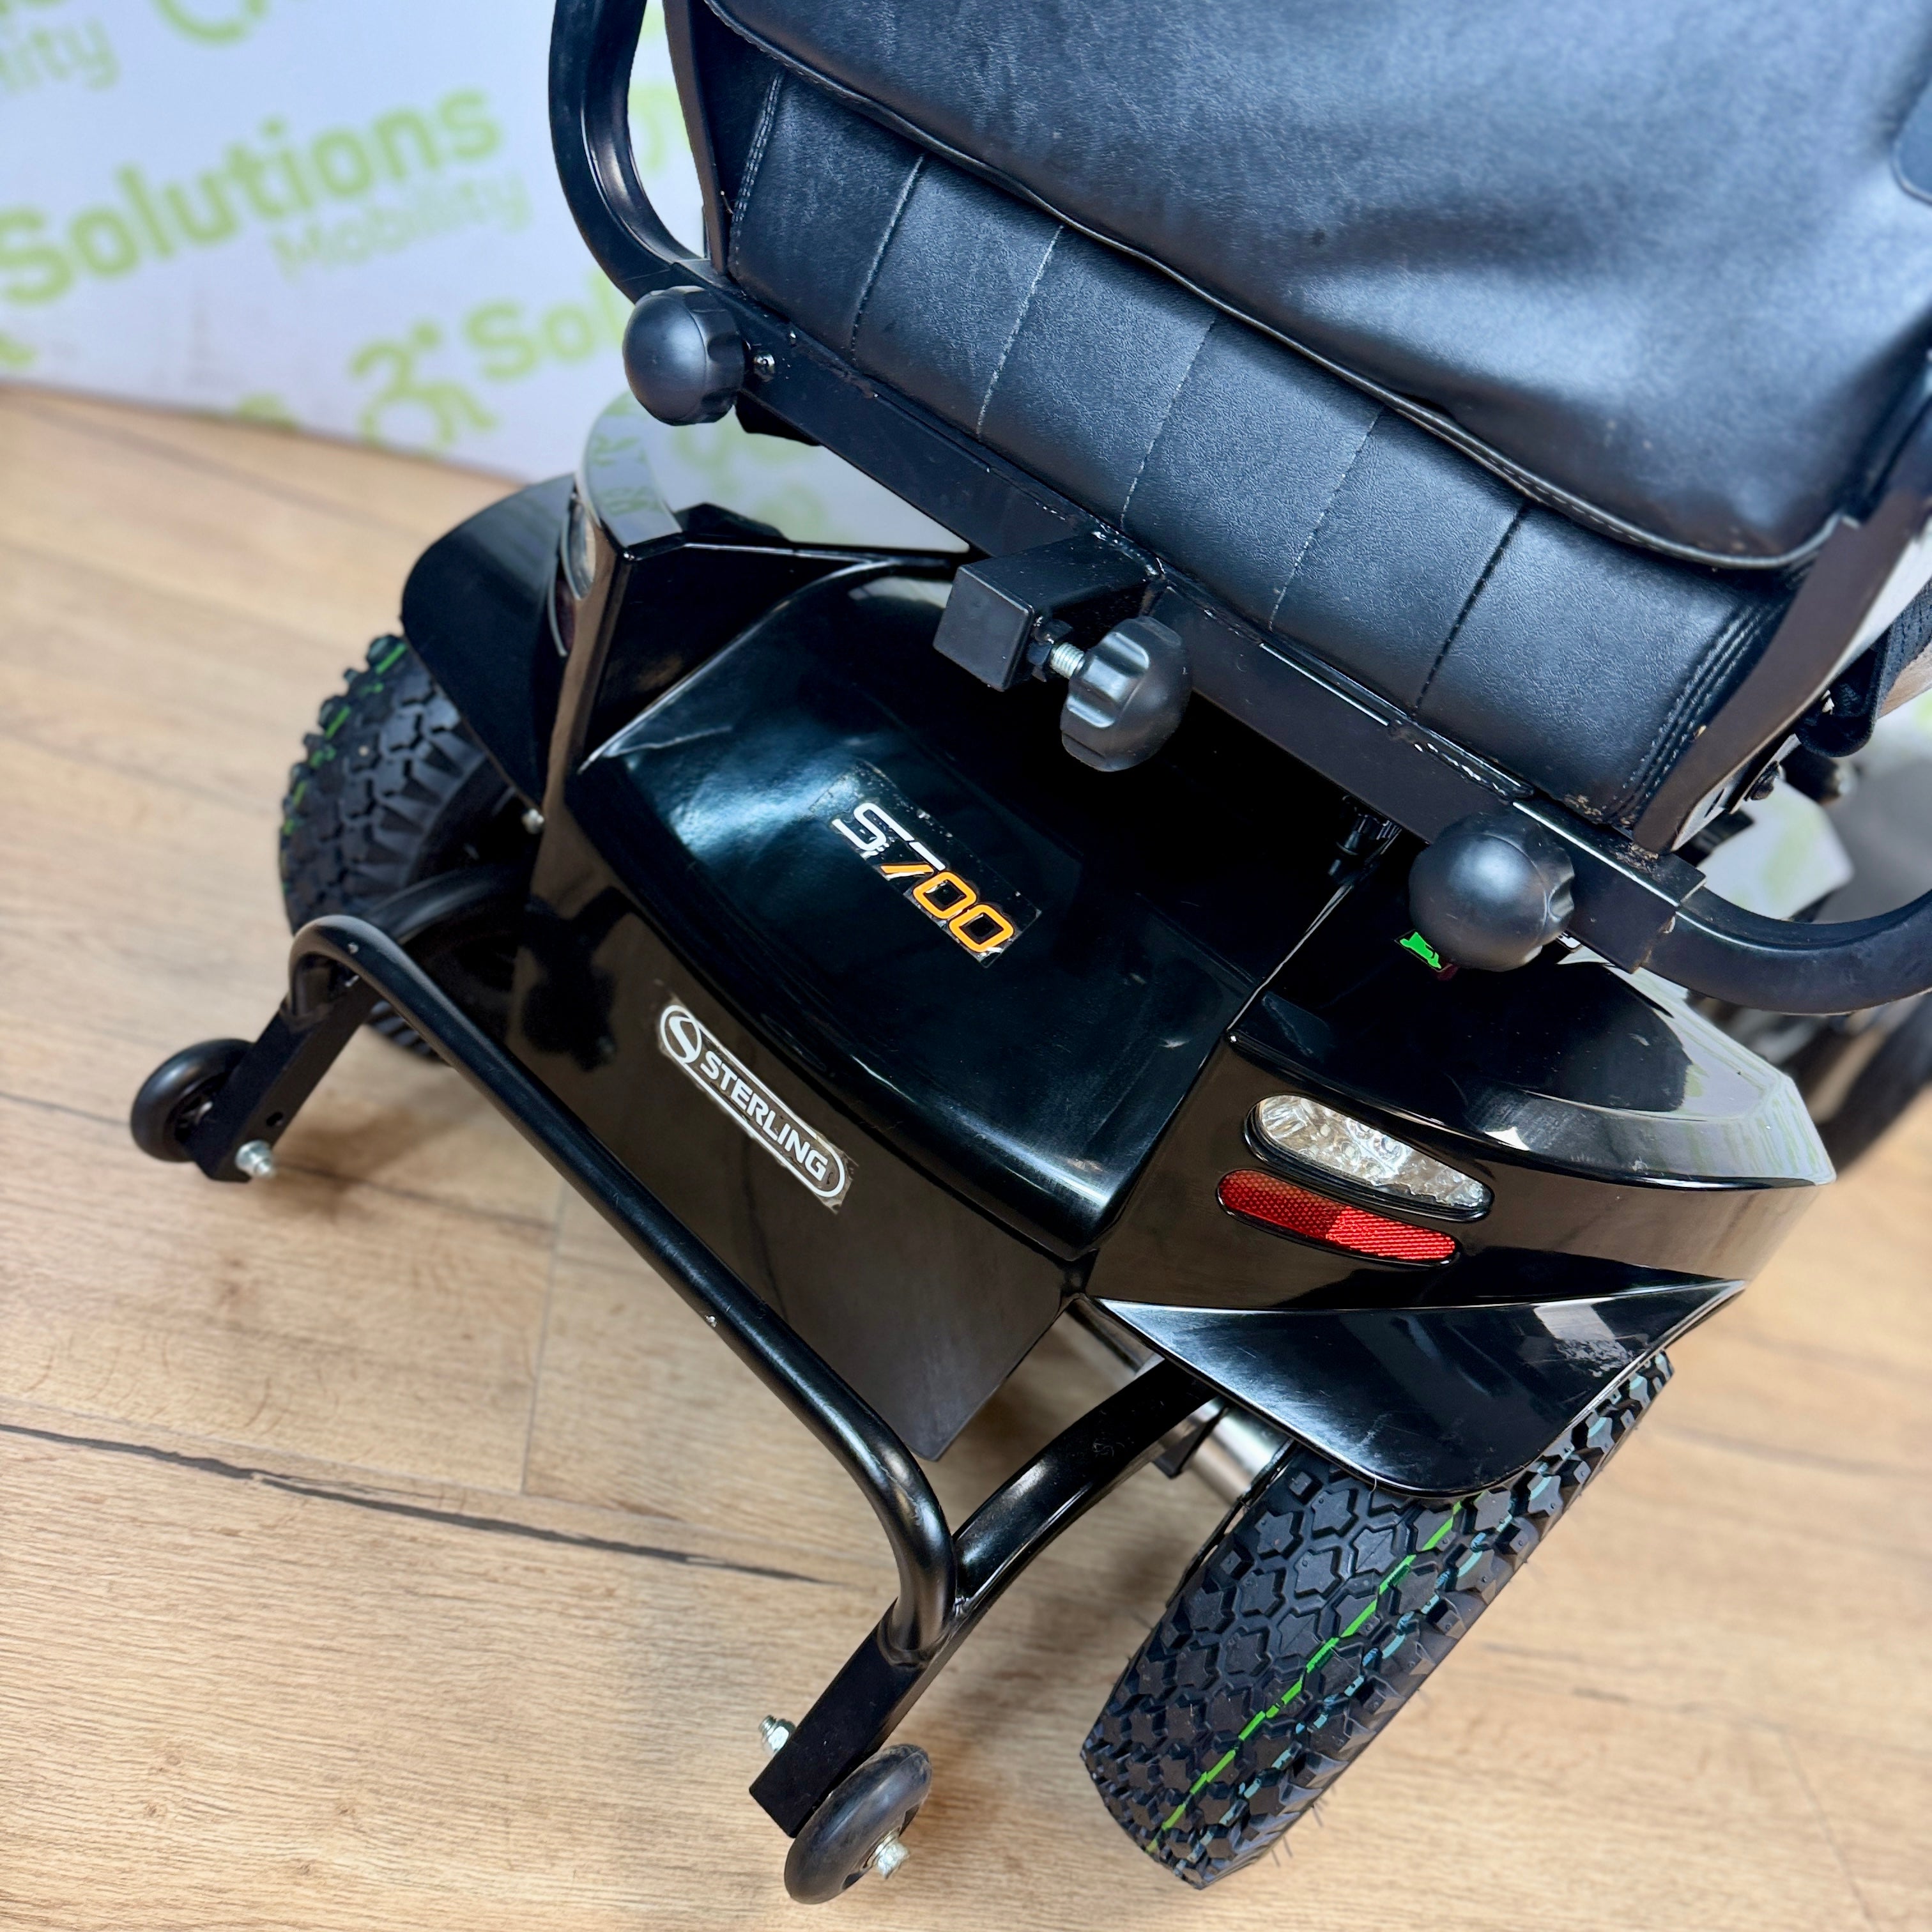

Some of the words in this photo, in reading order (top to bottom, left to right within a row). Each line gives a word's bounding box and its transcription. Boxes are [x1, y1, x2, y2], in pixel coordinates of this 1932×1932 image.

[0, 89, 503, 303] Solutions
[832, 802, 1015, 953] S700
[701, 1050, 829, 1181] STERLING
